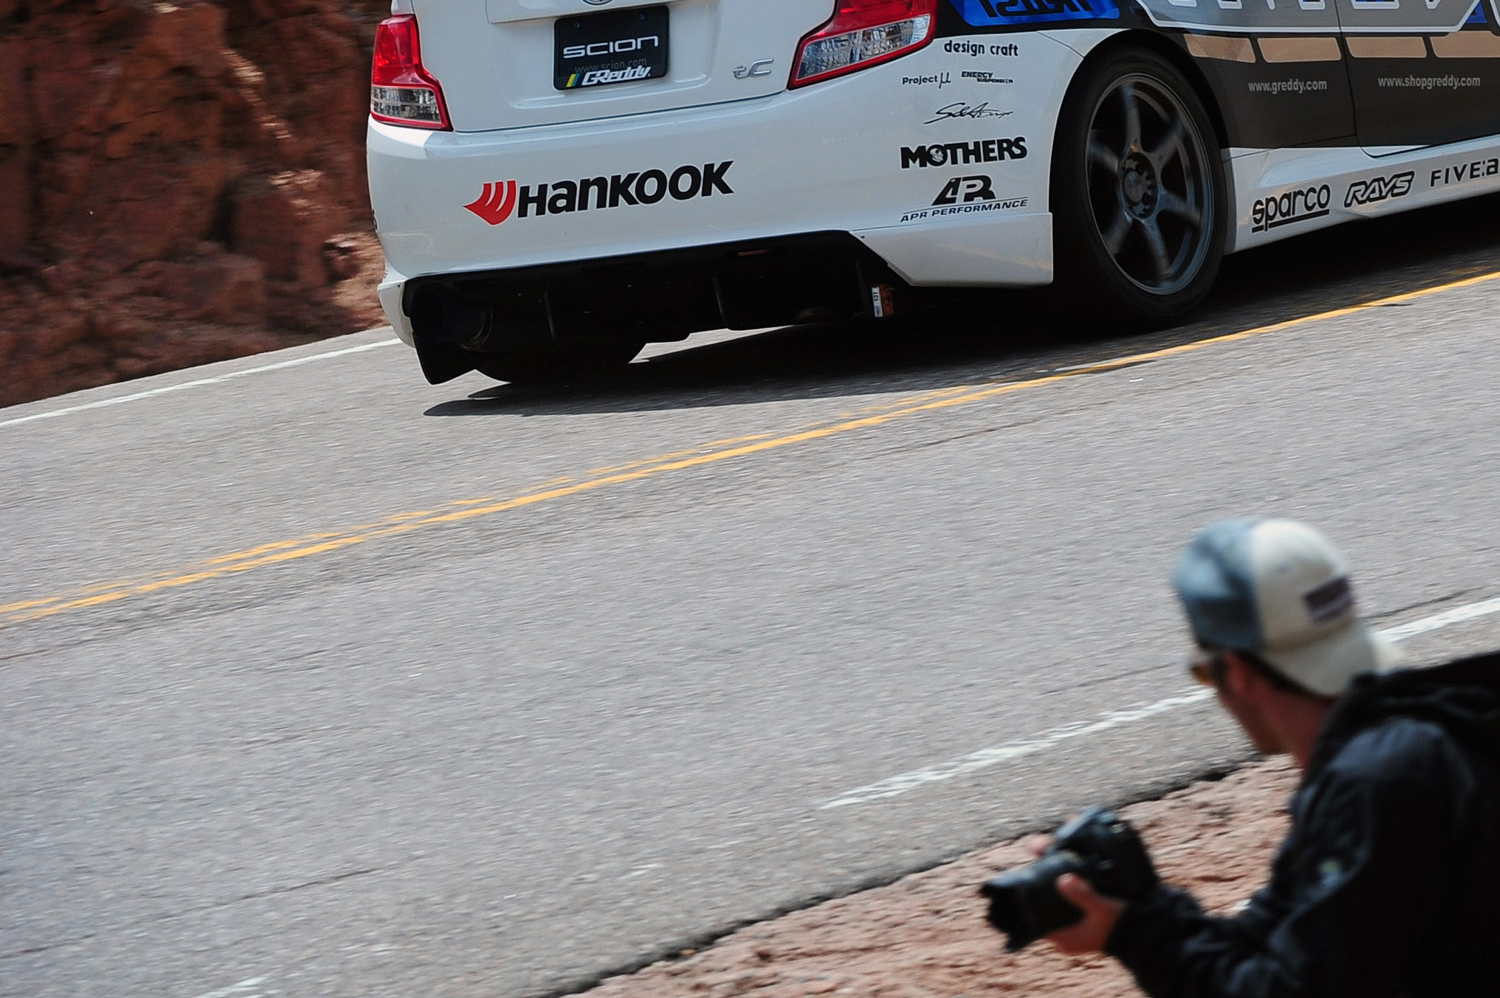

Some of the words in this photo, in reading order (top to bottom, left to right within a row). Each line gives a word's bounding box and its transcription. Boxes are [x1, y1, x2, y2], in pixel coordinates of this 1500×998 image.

[944, 40, 985, 57] design
[990, 43, 1018, 57] craft
[574, 57, 648, 74] www.scion.com
[1248, 78, 1328, 94] www.greddy.com
[1377, 74, 1481, 90] www.shopgreddy.com
[900, 137, 1028, 169] MOTHERS
[1251, 184, 1331, 231] sparco
[1344, 170, 1415, 208] RAYS
[900, 211, 928, 222] APR
[932, 199, 1029, 217] PERFORMANCE
